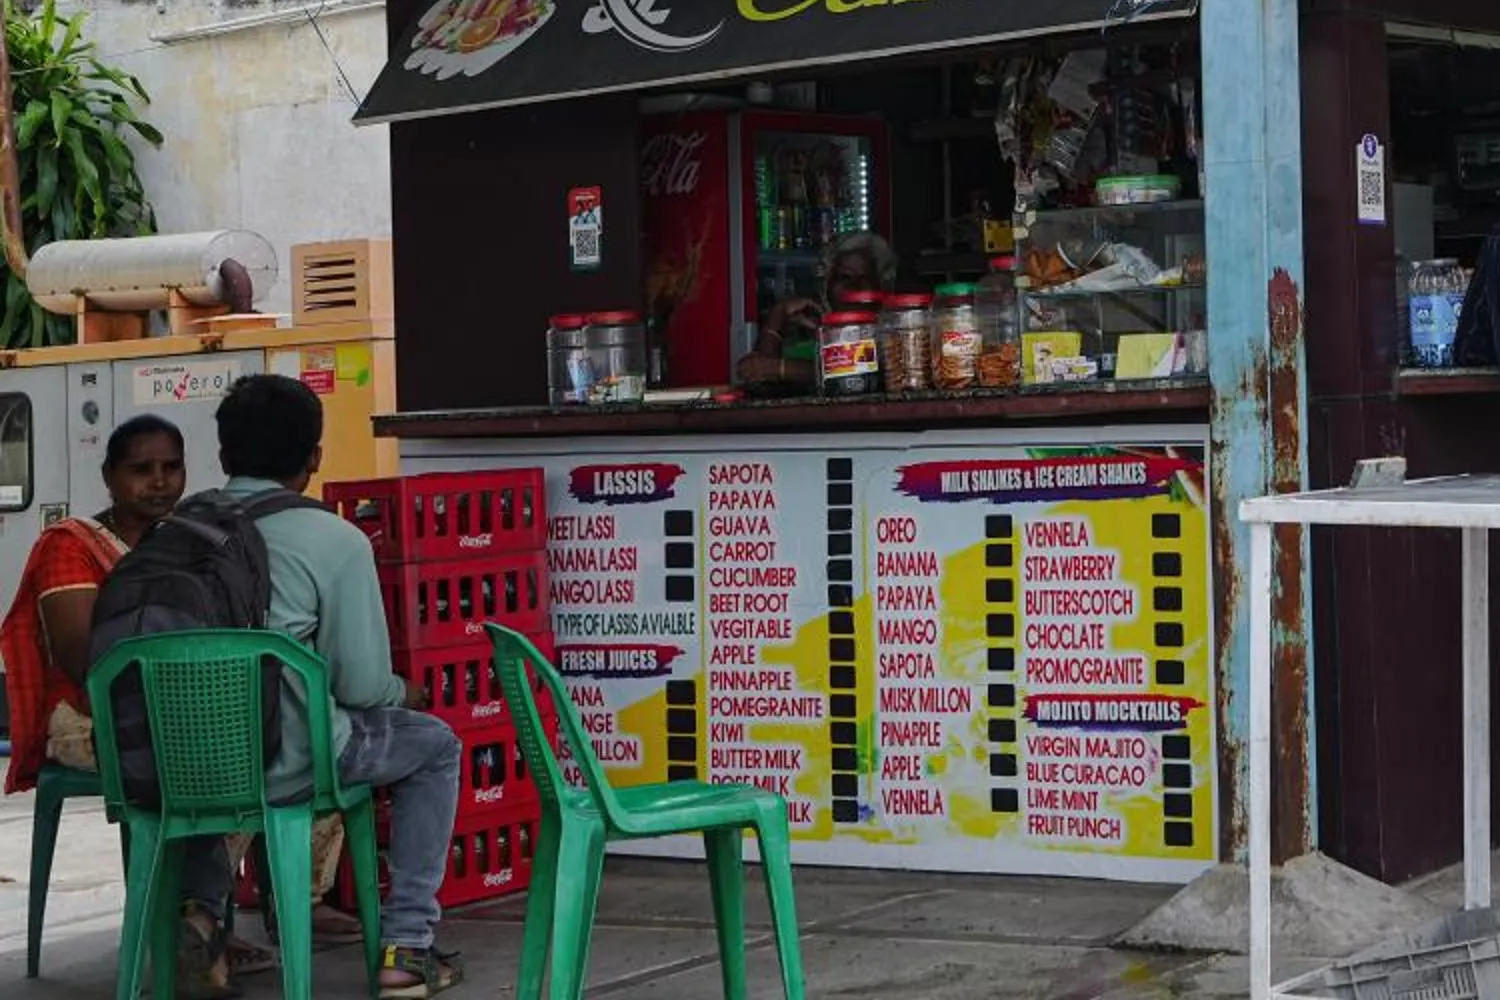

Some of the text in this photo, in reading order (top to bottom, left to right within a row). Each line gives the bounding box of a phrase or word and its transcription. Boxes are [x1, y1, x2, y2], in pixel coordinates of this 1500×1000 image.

[594, 469, 656, 495] LASSIS
[709, 464, 772, 485] SAPOTA
[941, 471, 970, 493] MILK
[1023, 470, 1033, 489] &
[1034, 466, 1054, 489] ICE
[1055, 464, 1098, 488] CREAM
[1099, 461, 1147, 486] SHAKES
[709, 490, 775, 511] PAPAYA
[577, 515, 615, 540] LASSI
[710, 516, 771, 537] GUAVA
[877, 517, 917, 543] OREO
[1025, 521, 1088, 547] VENNELA
[600, 547, 637, 572] LASSI
[710, 541, 776, 562] CARROT
[877, 552, 939, 577] BANANA
[1025, 555, 1116, 581] STRAWBERRY
[710, 567, 797, 588] CUCUMBER
[550, 579, 634, 604] ANGO LASSI
[710, 593, 788, 613] BEET ROOT
[877, 585, 936, 611] PAPAYA
[1025, 589, 1133, 615] BUTTERSCOTCH
[556, 613, 582, 636] TYPE
[583, 613, 599, 636] OF
[711, 619, 792, 640] VEGITABLE
[879, 619, 937, 645] MANGO
[1026, 623, 1105, 649] CHOCLATE
[561, 649, 657, 672] FRESH JUICES
[711, 645, 755, 665] APPLE
[879, 653, 935, 679] SAPOTA
[711, 671, 792, 691] PINNAPPLE
[1026, 657, 1144, 684] PROMOGRANITE
[711, 696, 823, 718] POMEGRANITE
[880, 687, 972, 713] MUSK MILLON
[1037, 700, 1181, 721] MOJITO MOCKTAILS
[711, 722, 745, 743] KIWI
[881, 721, 941, 747] PINAPPLE
[711, 748, 801, 770] BUTTER MILK
[1026, 735, 1146, 759] VIRGIN MAJITO
[882, 755, 921, 781] APPLE
[1026, 762, 1145, 787] BLUE CURACAO
[788, 801, 812, 823] ILK
[882, 788, 944, 816] VENNELA
[1027, 788, 1099, 811] LIME MINT
[1028, 813, 1121, 840] FRUIT PUNCH
